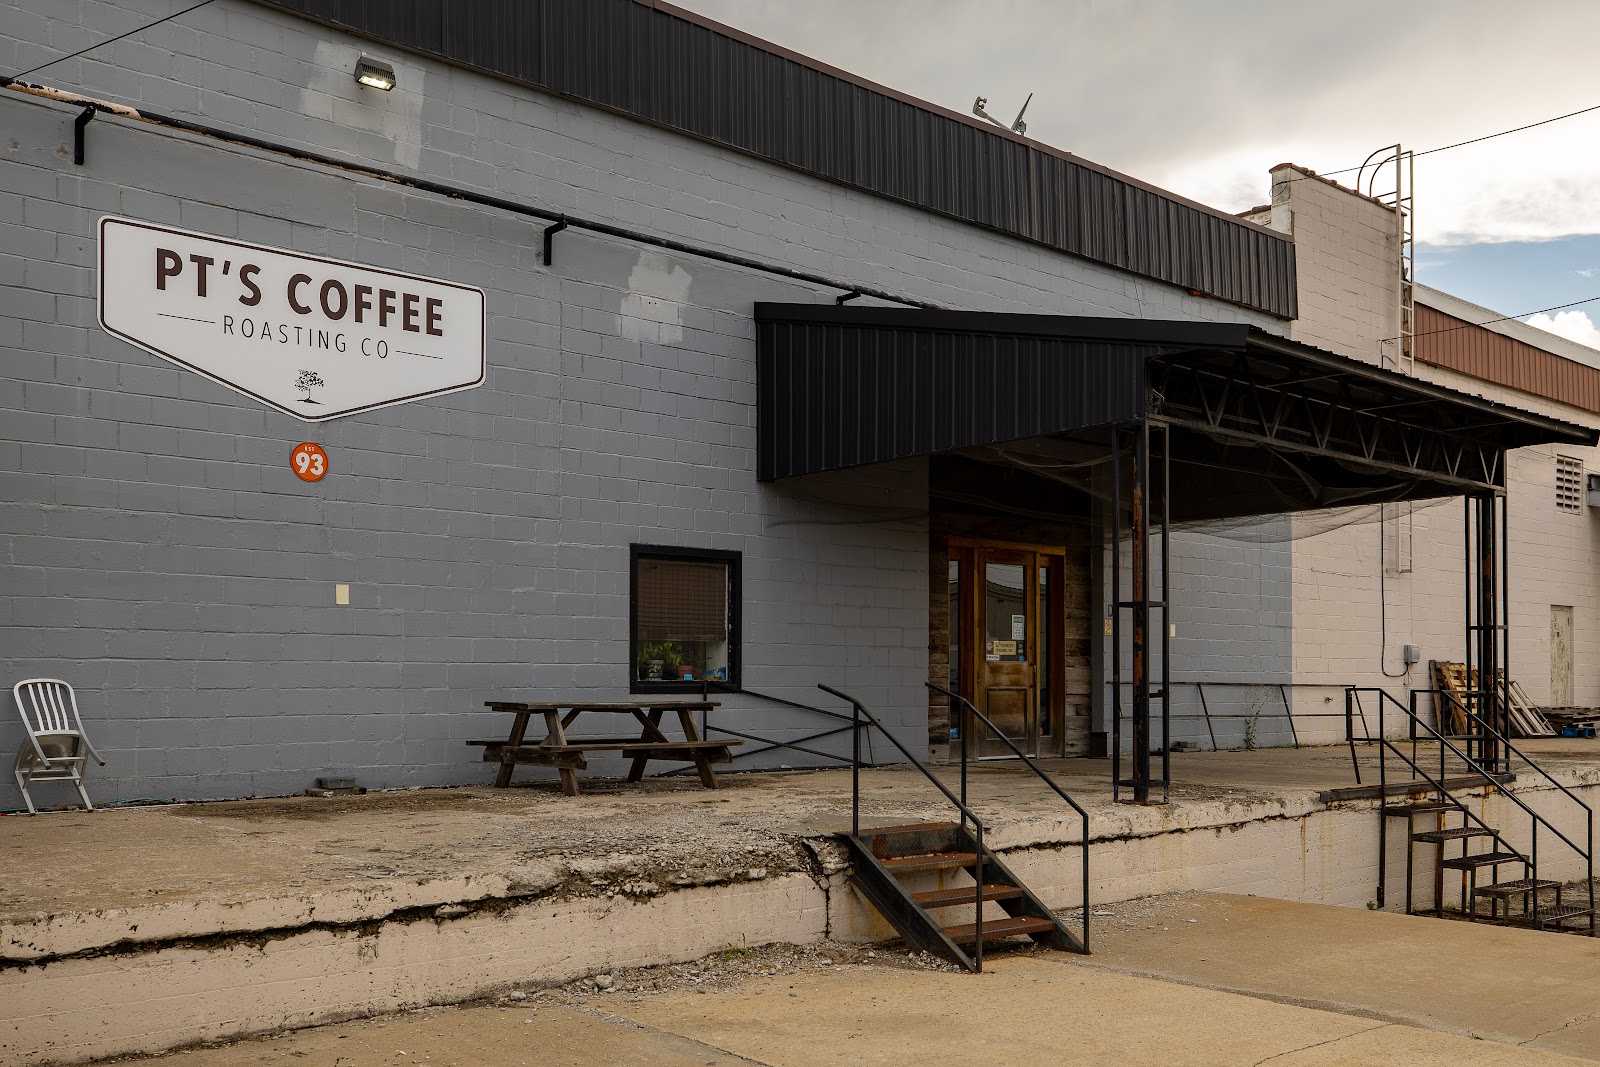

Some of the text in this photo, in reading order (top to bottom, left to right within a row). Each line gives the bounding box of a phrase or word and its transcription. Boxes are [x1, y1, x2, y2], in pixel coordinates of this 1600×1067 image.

[156, 247, 443, 337] PT'S COFFEE
[223, 315, 388, 359] ROASTING CO
[295, 451, 323, 475] 93
